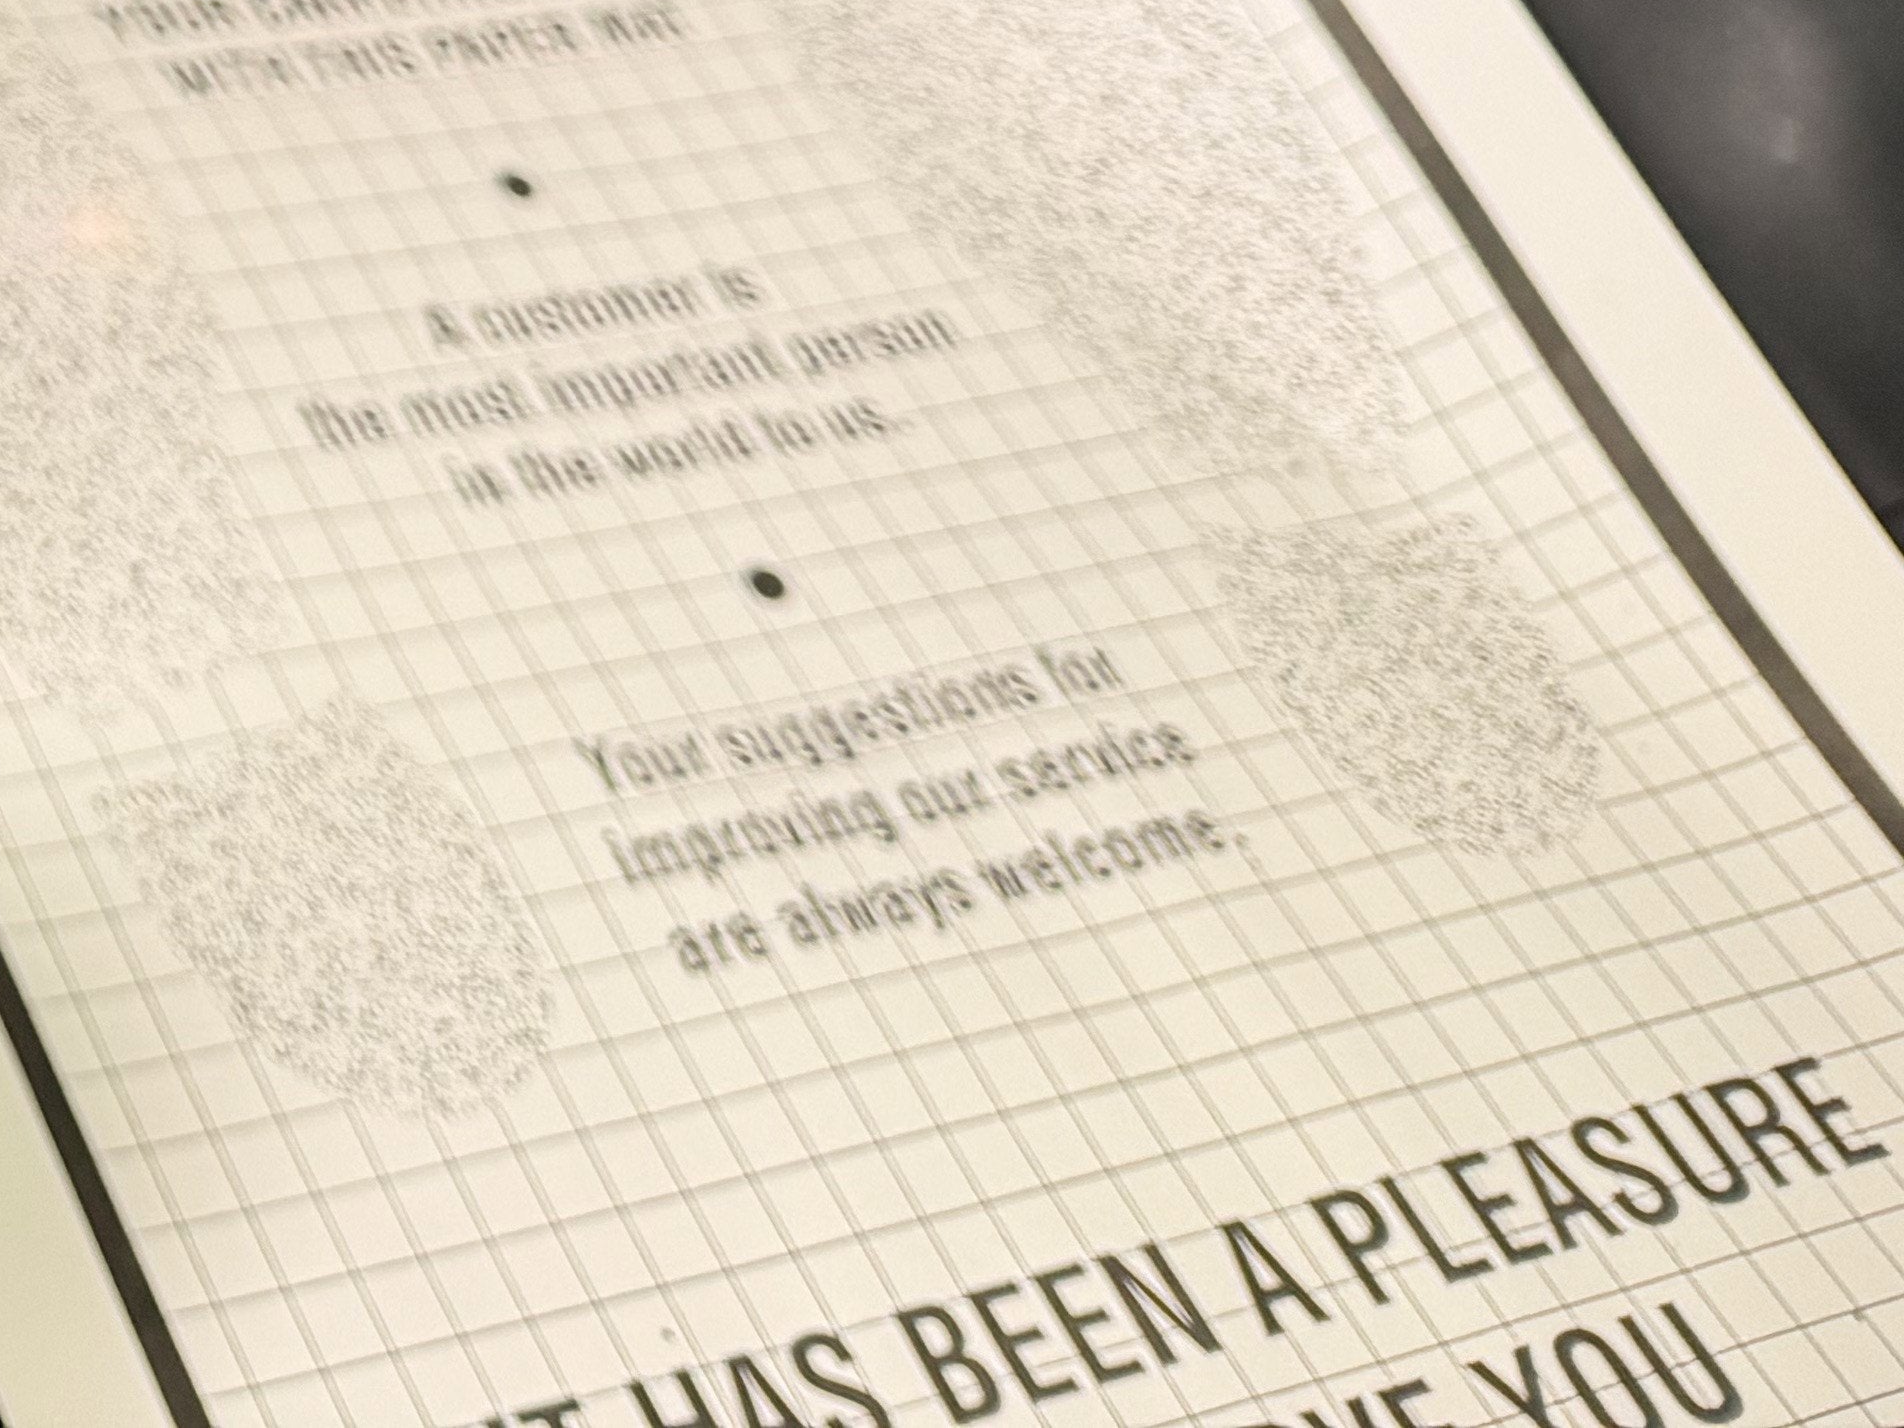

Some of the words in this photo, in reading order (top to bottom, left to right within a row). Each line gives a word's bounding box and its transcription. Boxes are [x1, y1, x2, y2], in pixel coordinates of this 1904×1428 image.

[298, 392, 394, 453] the
[399, 375, 532, 440] most
[533, 329, 785, 420] important
[784, 305, 962, 381] person
[423, 301, 466, 346] A
[470, 273, 701, 346] customer
[703, 260, 763, 312] is
[508, 441, 602, 502] the
[605, 412, 755, 480] world
[755, 404, 818, 459] to
[573, 732, 713, 797] Your
[717, 656, 1042, 770] suggestions
[1036, 641, 1127, 695] for
[601, 784, 900, 887] improving
[897, 771, 993, 825] our
[995, 716, 1199, 803] service
[667, 906, 772, 977] are
[775, 865, 977, 951] always
[977, 805, 1252, 900] welcome.
[891, 1241, 1224, 1428] BEEN
[1217, 1218, 1333, 1338] A
[1308, 1055, 1892, 1307] PLEASURE
[1466, 1301, 1747, 1428] YOU
